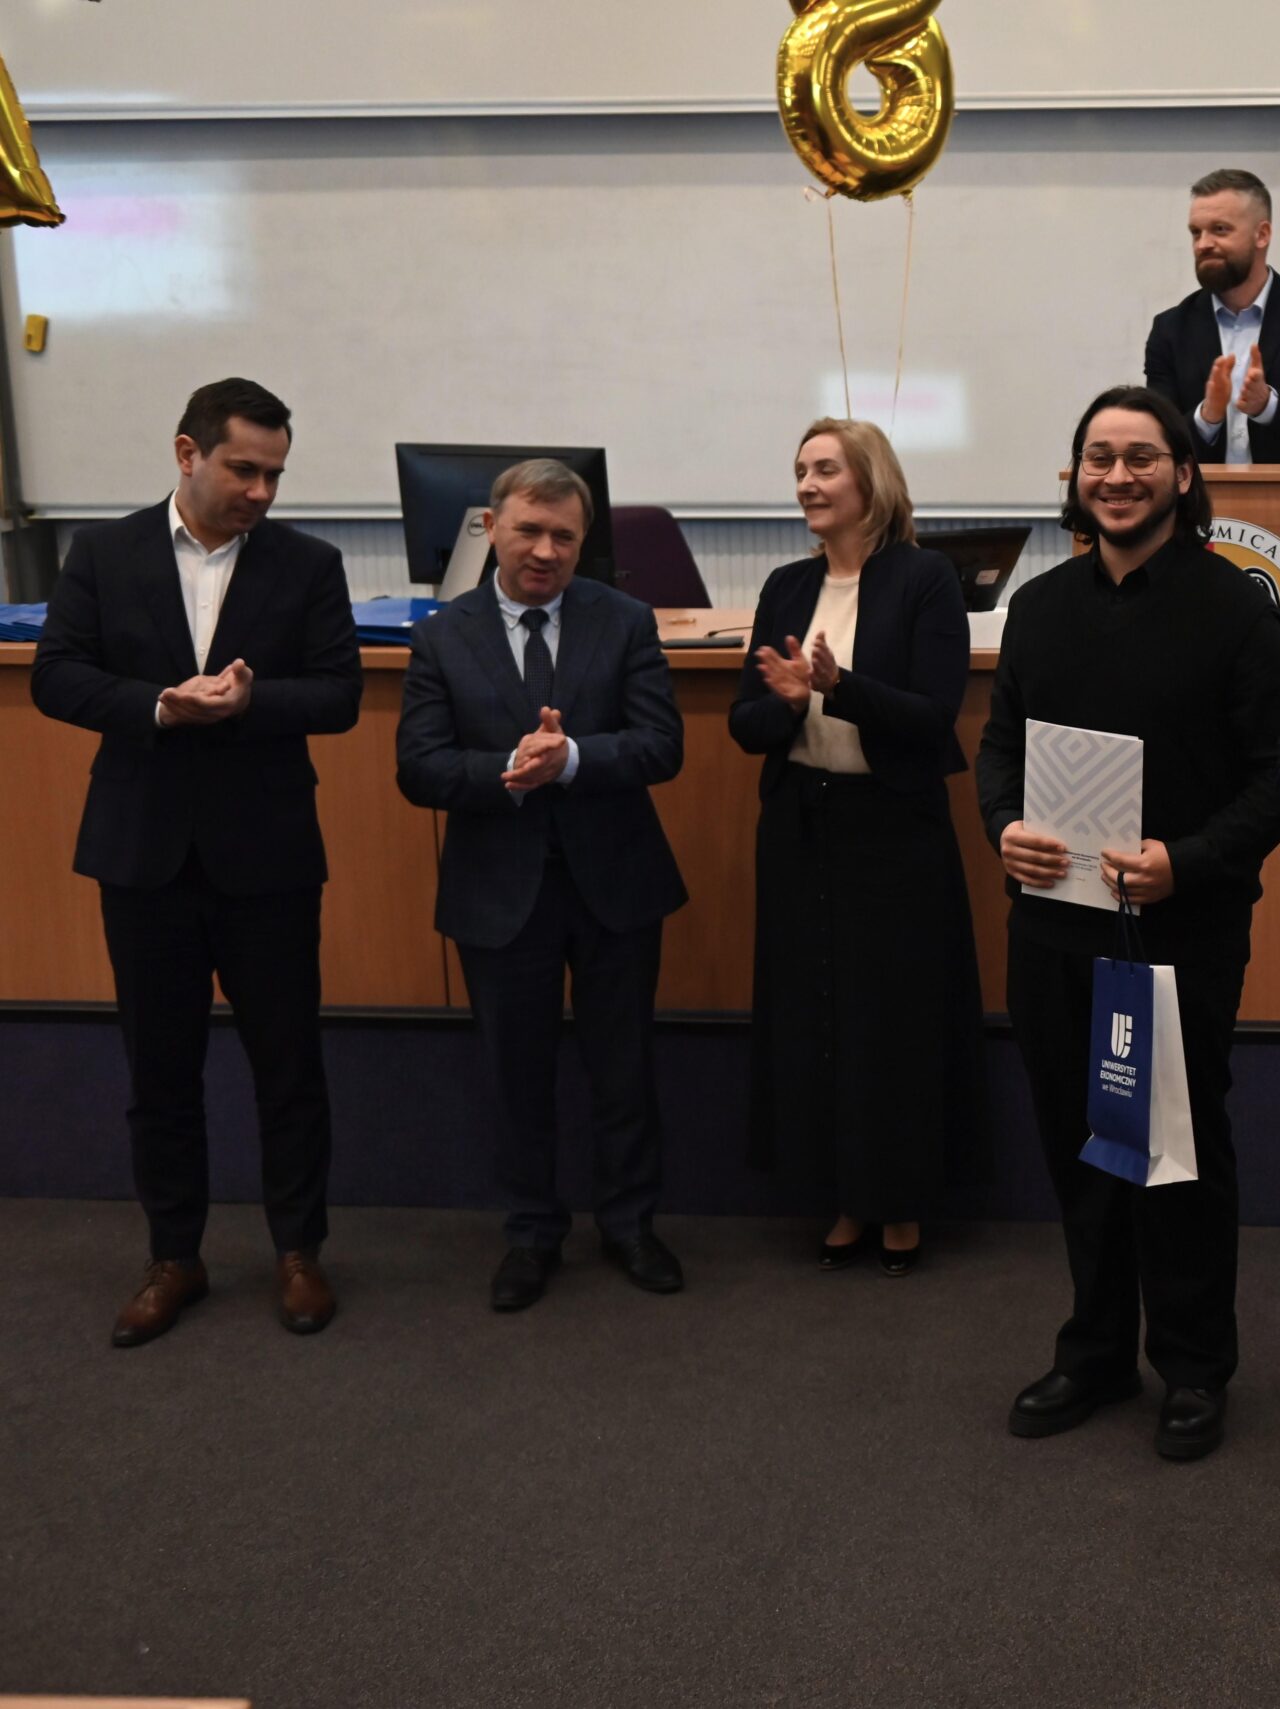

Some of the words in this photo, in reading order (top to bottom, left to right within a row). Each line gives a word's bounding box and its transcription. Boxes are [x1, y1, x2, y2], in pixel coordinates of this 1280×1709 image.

[1211, 525, 1278, 559] MICA
[1101, 1059, 1137, 1076] UNIWERSYTET
[1100, 1070, 1137, 1087] EKONOMICZNY
